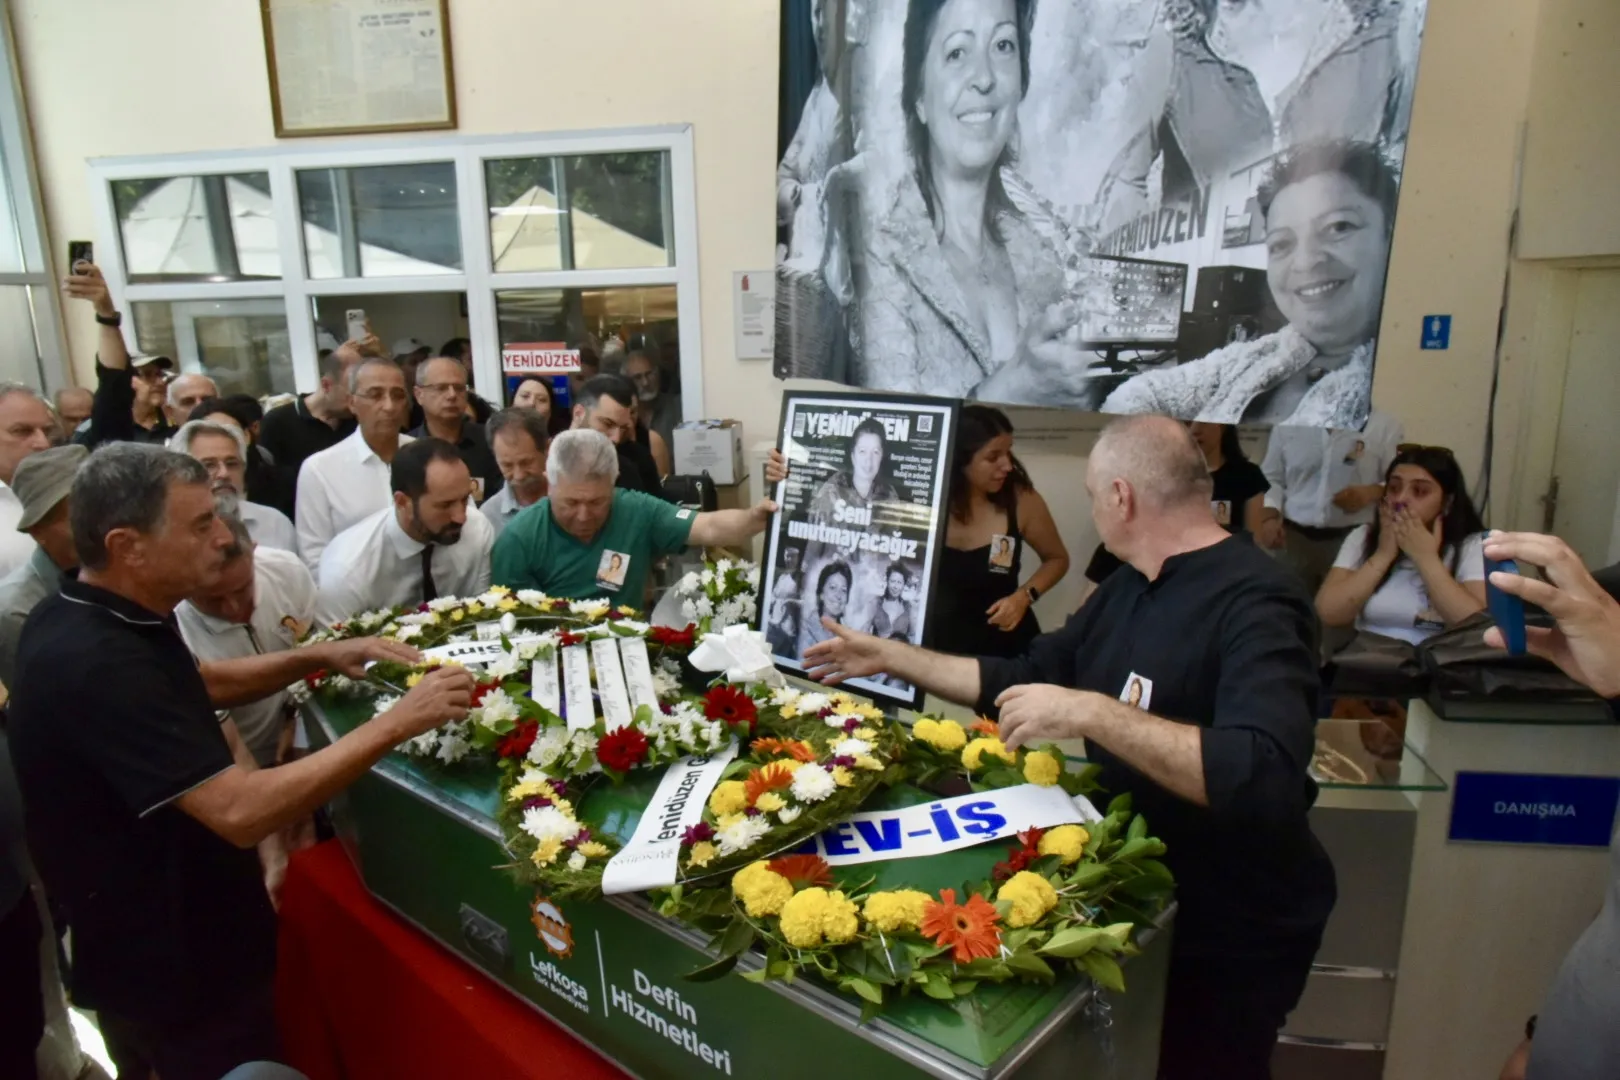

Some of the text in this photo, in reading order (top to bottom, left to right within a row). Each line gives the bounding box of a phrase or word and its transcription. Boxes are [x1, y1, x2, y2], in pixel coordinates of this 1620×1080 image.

[504, 351, 581, 368] YENİDÜZEN
[833, 498, 873, 526] Seni
[1494, 801, 1576, 819] DANIŞMA
[530, 951, 588, 1001] Lefkoşa
[633, 968, 697, 1025] Defin
[610, 984, 731, 1076] Hizmetleri
